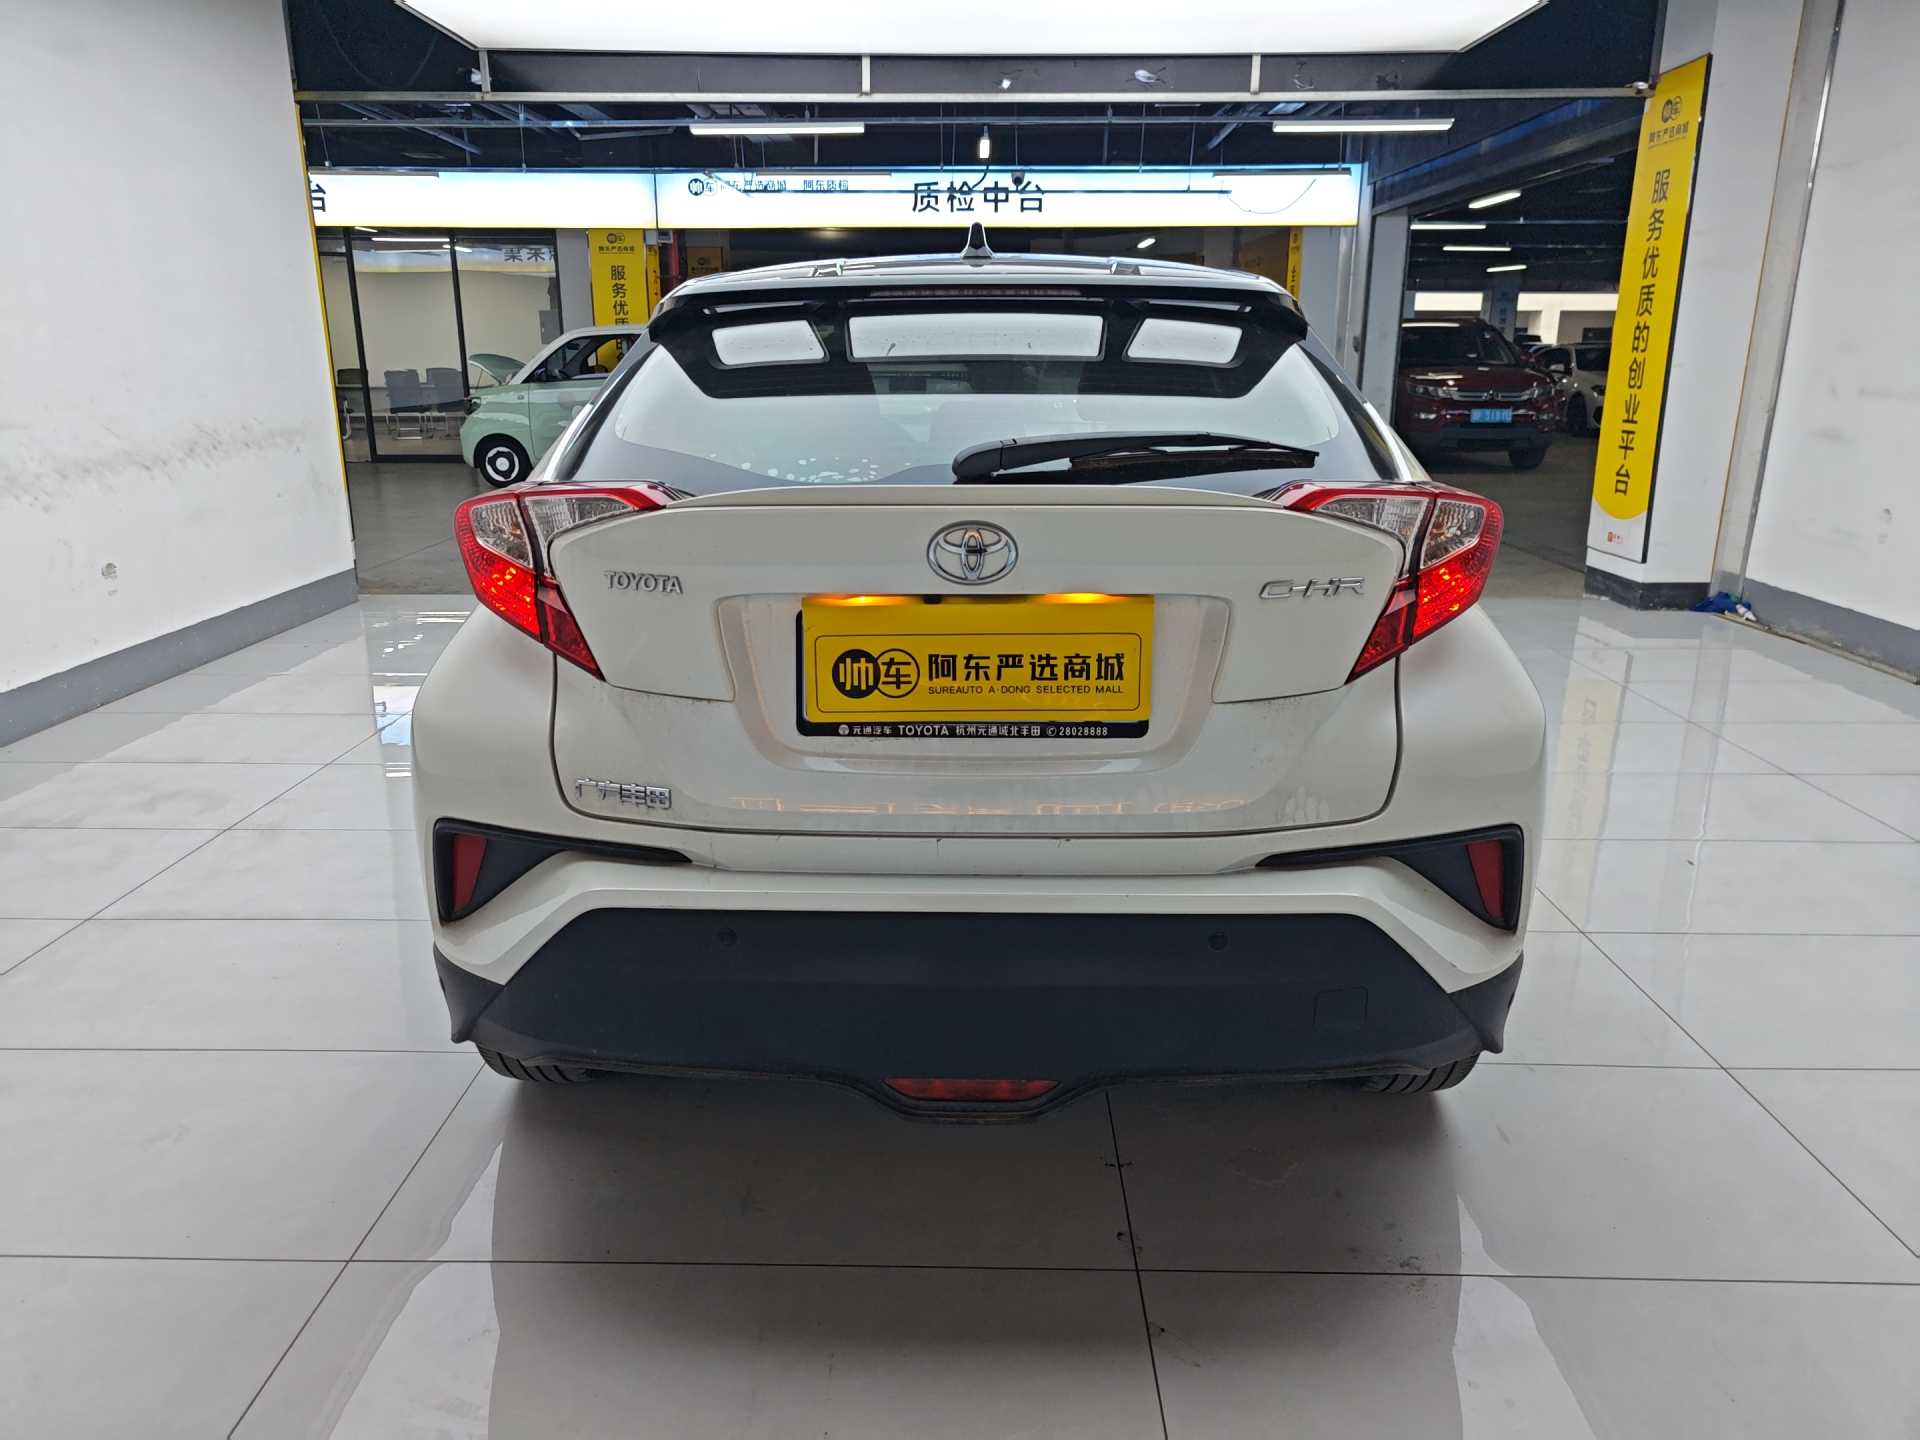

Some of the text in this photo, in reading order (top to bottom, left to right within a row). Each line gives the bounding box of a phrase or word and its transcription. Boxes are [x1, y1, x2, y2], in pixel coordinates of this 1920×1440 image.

[912, 181, 1045, 213] 质检中台
[1614, 169, 1671, 496] 服务优质的创业平台
[603, 570, 684, 594] TOYOTA
[1259, 577, 1365, 600] C-HR
[928, 653, 1124, 681] 阿东严选商城
[928, 686, 983, 695] SUREAUTO
[1036, 685, 1091, 694] SELECTED
[1095, 685, 1123, 694] MALL
[898, 724, 950, 736] TOYOTA
[1059, 726, 1109, 736] 28028888
